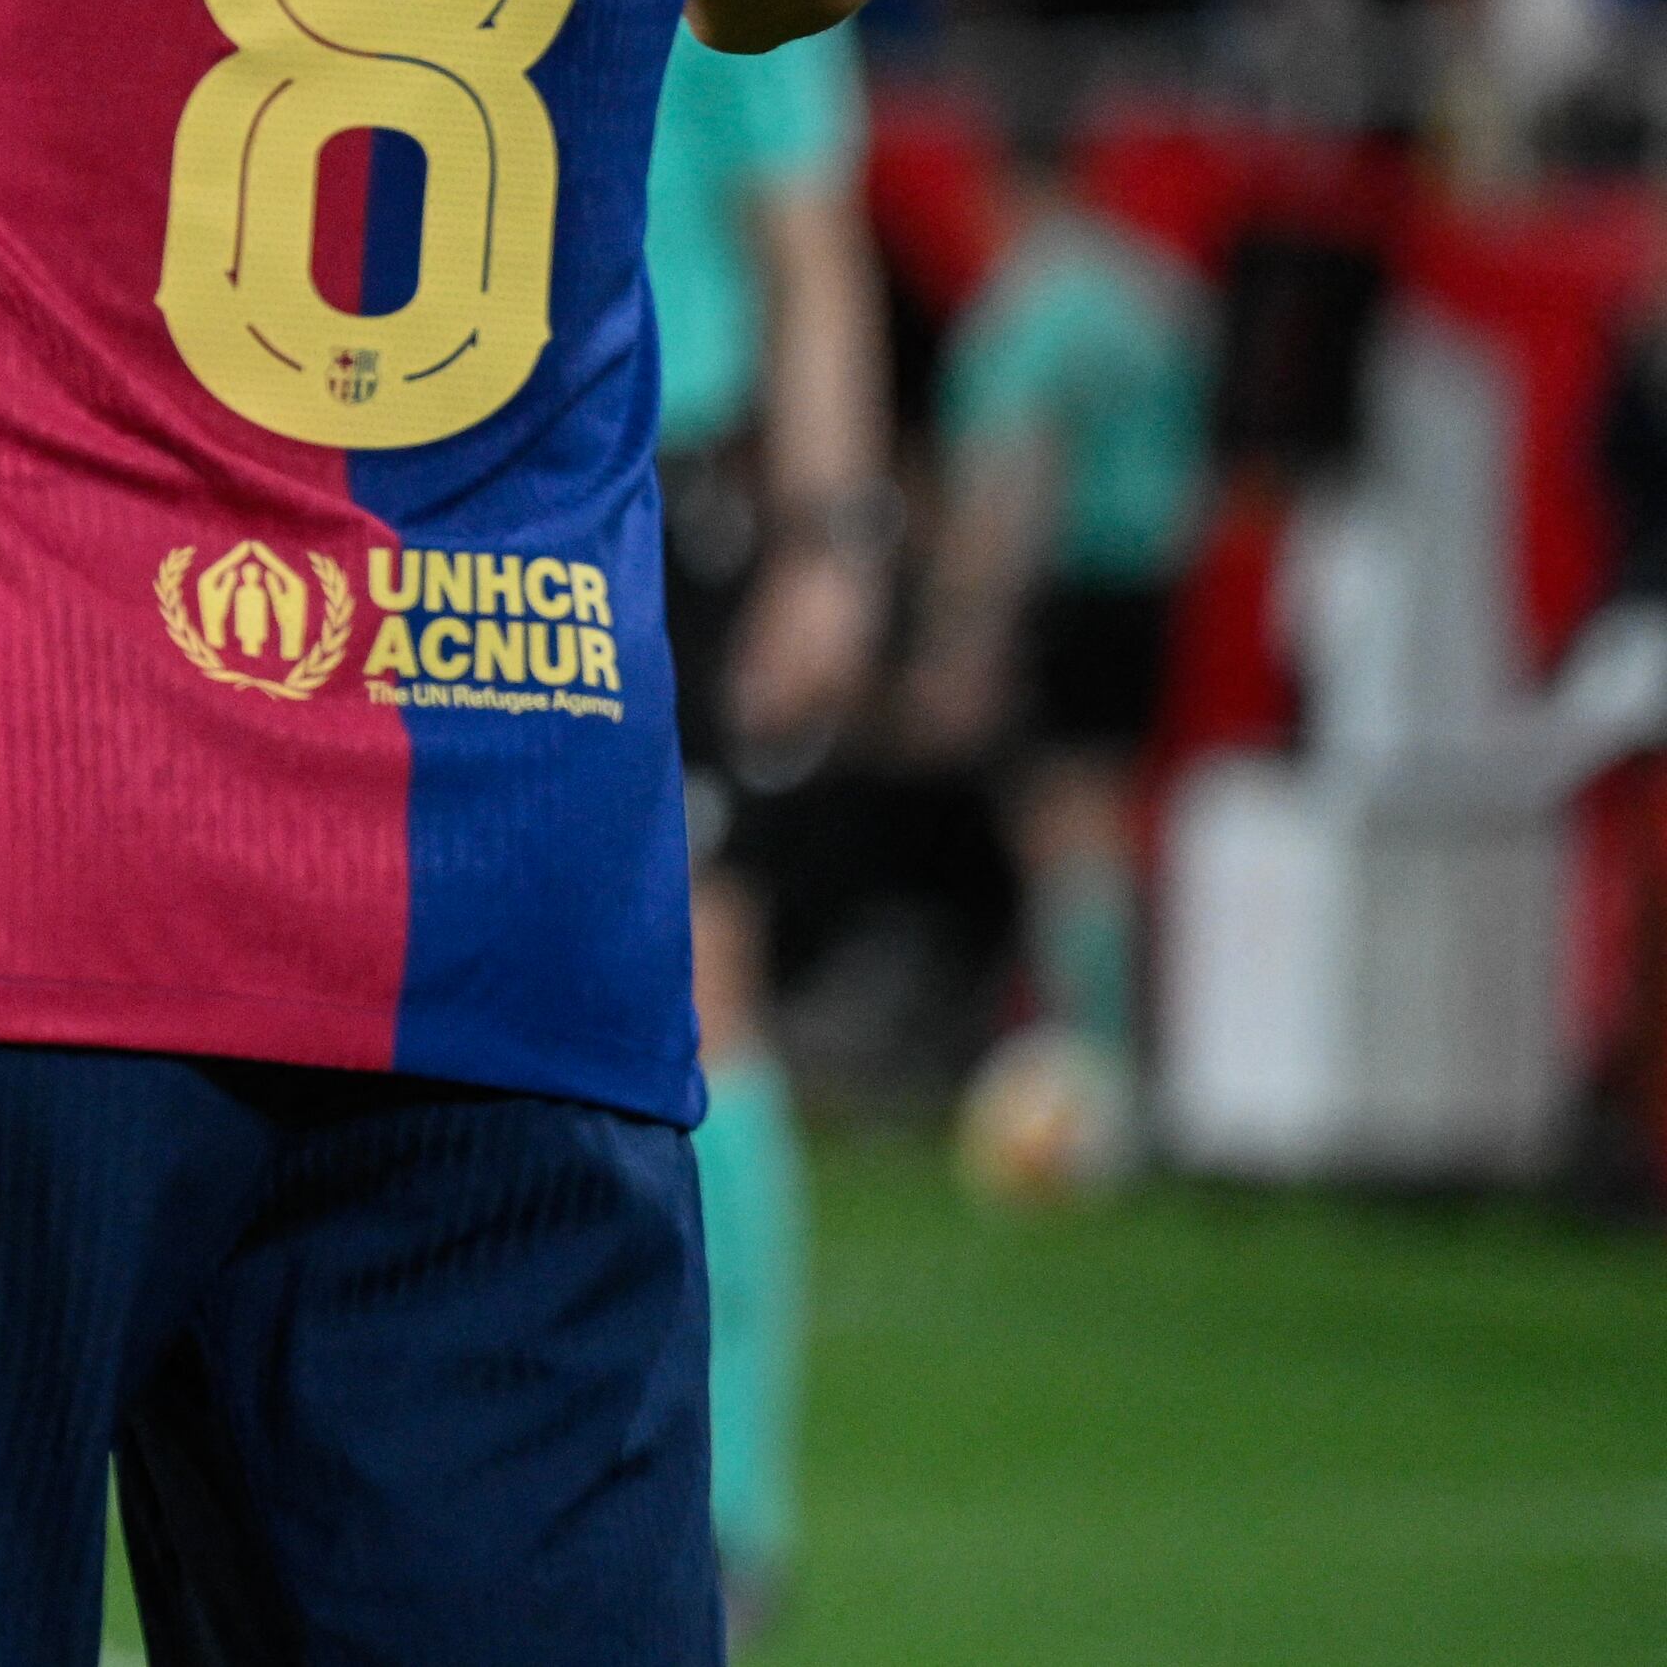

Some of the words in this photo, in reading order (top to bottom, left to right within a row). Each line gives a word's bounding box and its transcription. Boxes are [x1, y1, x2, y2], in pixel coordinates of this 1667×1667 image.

[367, 548, 613, 627] UNHCR
[363, 615, 621, 691] ACNUR
[366, 680, 409, 706] The
[413, 683, 450, 707] UN
[452, 685, 549, 715] Refugee
[553, 689, 624, 724] Agency
